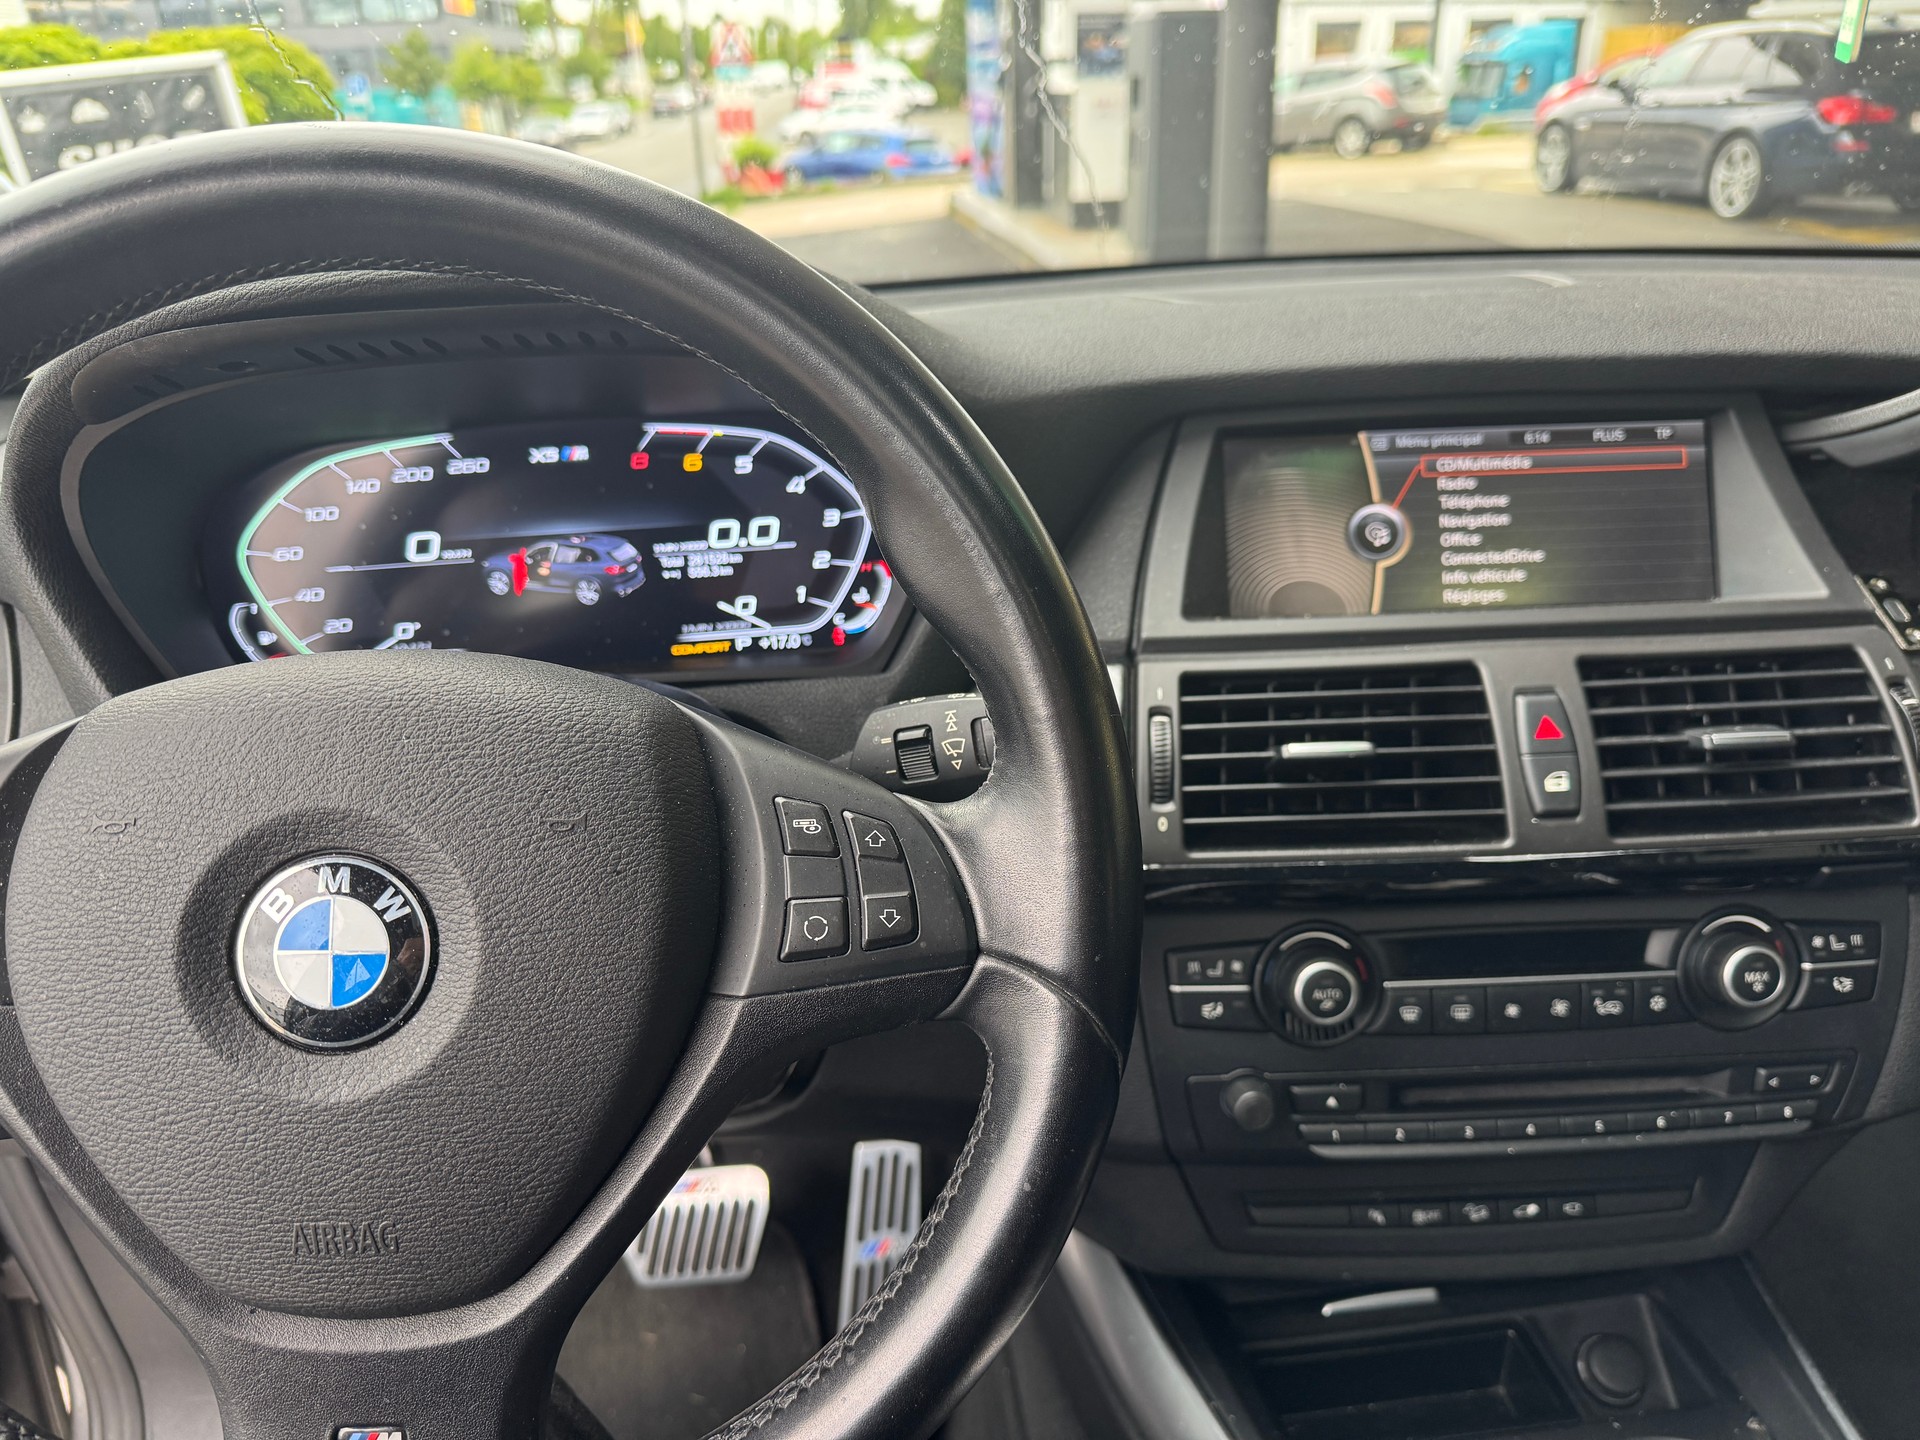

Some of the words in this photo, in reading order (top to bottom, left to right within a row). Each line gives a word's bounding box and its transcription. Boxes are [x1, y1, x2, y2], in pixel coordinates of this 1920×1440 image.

[1593, 428, 1627, 442] PLUS
[528, 446, 559, 464] X5
[683, 453, 703, 472] 6
[734, 454, 753, 474] 5
[391, 466, 434, 484] 200
[446, 457, 490, 475] 260
[346, 478, 381, 494] 140
[786, 474, 806, 494] 4
[1437, 476, 1479, 491] Radio
[304, 506, 340, 522] 100
[822, 508, 841, 528] 3
[1439, 513, 1512, 530] Navigation
[707, 515, 781, 549] 0.0
[1440, 532, 1483, 548] Office
[272, 546, 304, 561] 60
[405, 531, 441, 563] 0
[812, 550, 831, 569] 2
[1441, 548, 1546, 566] ConnectedDrive
[294, 587, 325, 603] 40
[795, 585, 807, 603] 1
[734, 595, 758, 617] 0
[322, 618, 353, 634] 20
[670, 641, 732, 656] COMFORT
[734, 636, 753, 652] P
[260, 866, 412, 925] BMW
[1744, 970, 1770, 984] MAX
[1312, 987, 1343, 1001] AUTO
[291, 1221, 400, 1255] AIRBAG
